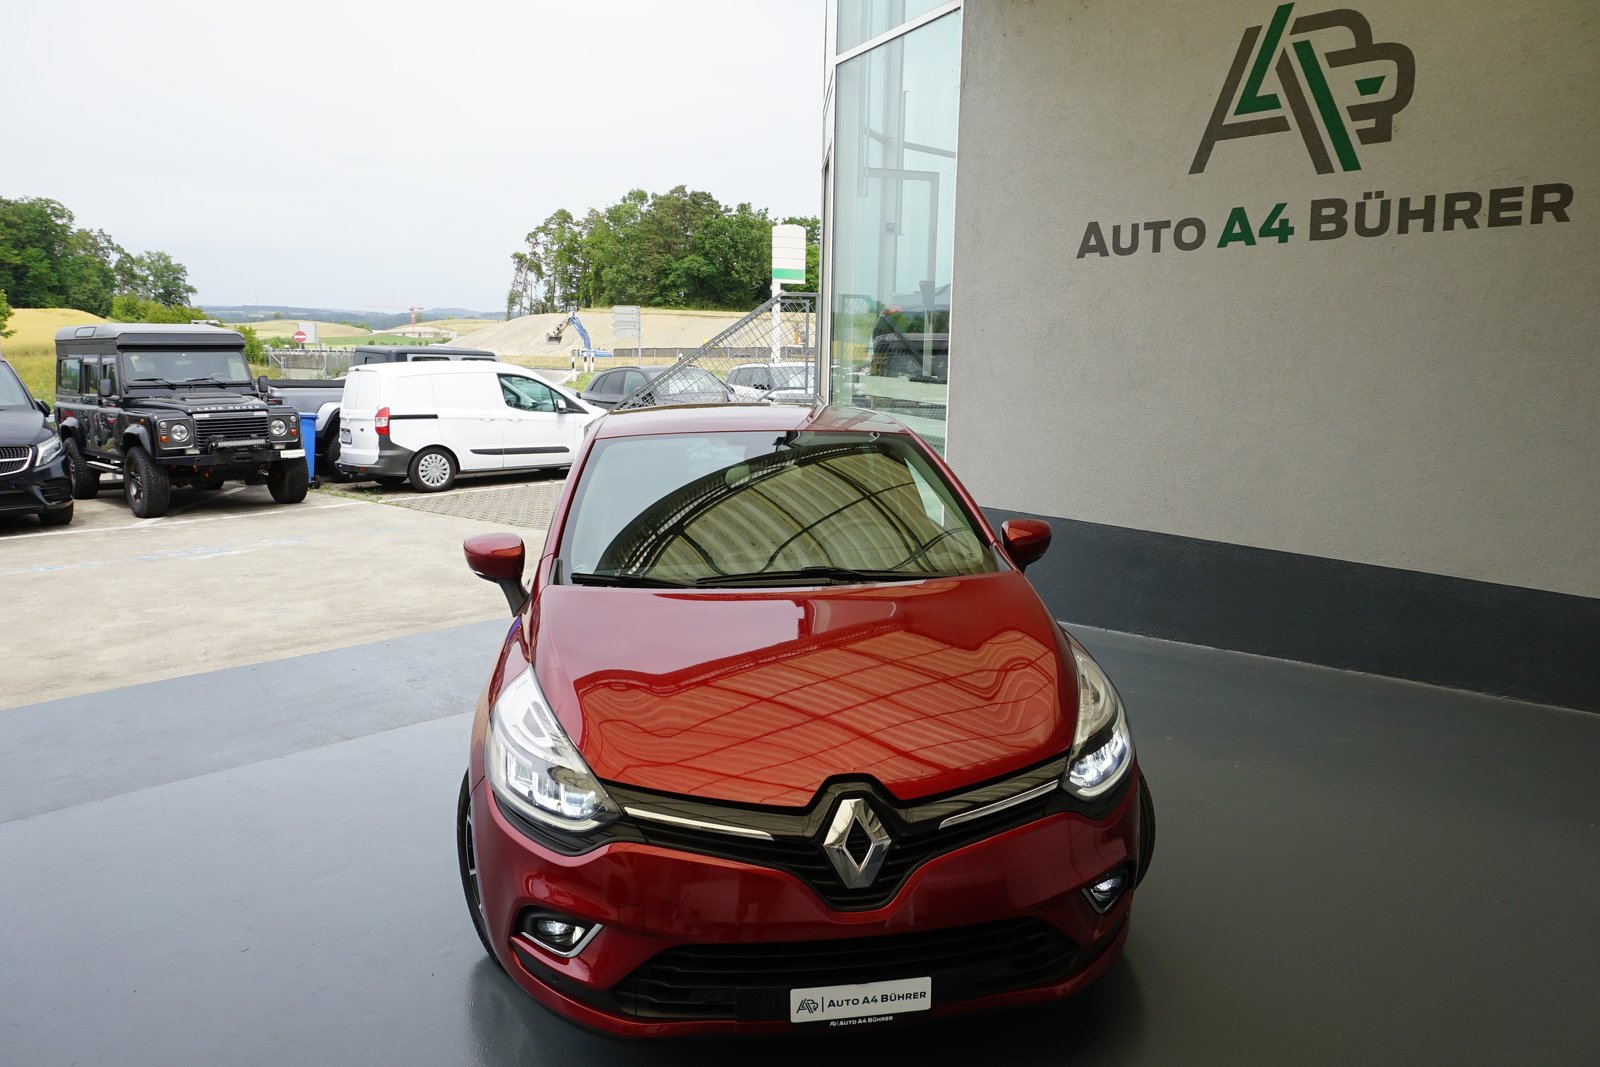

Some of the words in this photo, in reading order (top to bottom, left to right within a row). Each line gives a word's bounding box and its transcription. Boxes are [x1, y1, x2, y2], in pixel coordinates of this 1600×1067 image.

[1076, 217, 1206, 260] AUTO
[1216, 202, 1295, 249] A4
[1308, 182, 1575, 242] BÜHRER
[827, 998, 860, 1008] AUTO
[861, 995, 878, 1005] A4
[880, 991, 927, 1003] BÜHRER
[838, 1019, 857, 1027] AUTO
